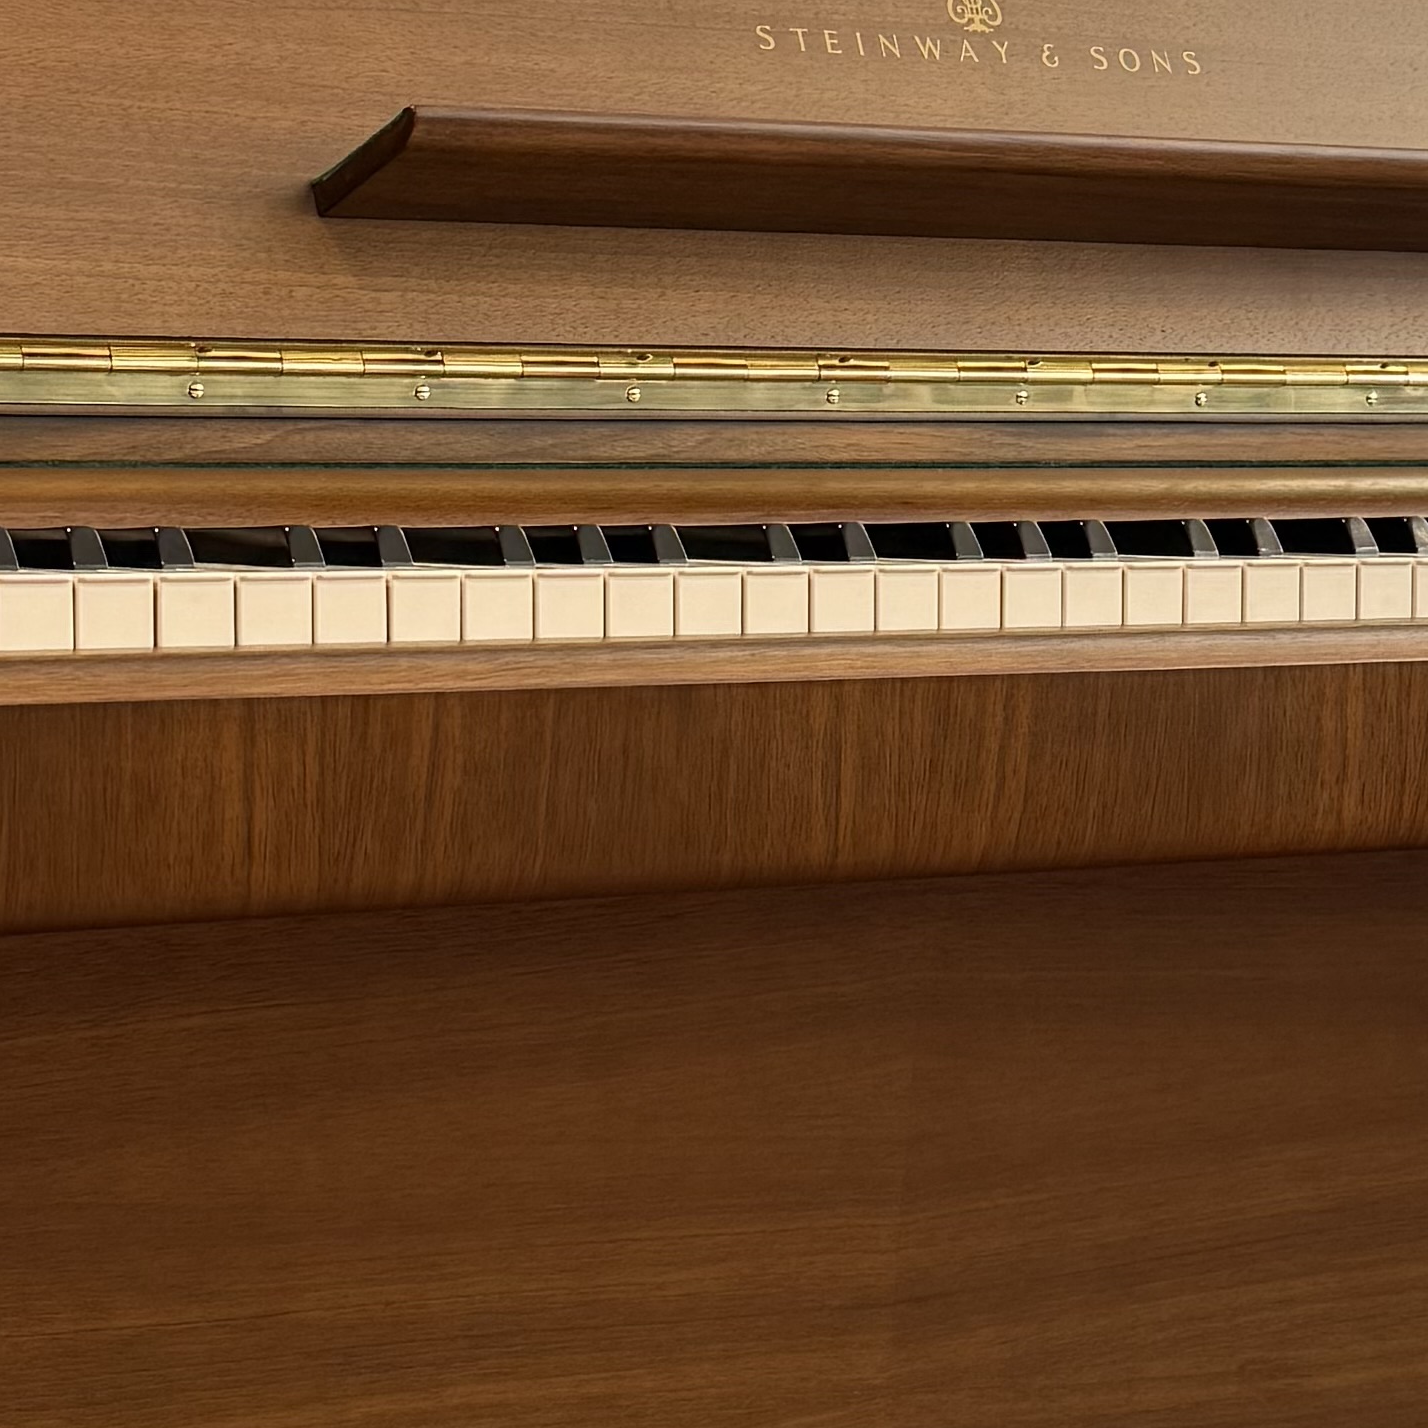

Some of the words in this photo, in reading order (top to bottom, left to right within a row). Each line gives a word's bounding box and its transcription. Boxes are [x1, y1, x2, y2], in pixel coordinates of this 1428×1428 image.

[754, 25, 1010, 65] STEINWAY
[1041, 43, 1061, 68] &
[1089, 45, 1203, 76] SONS
